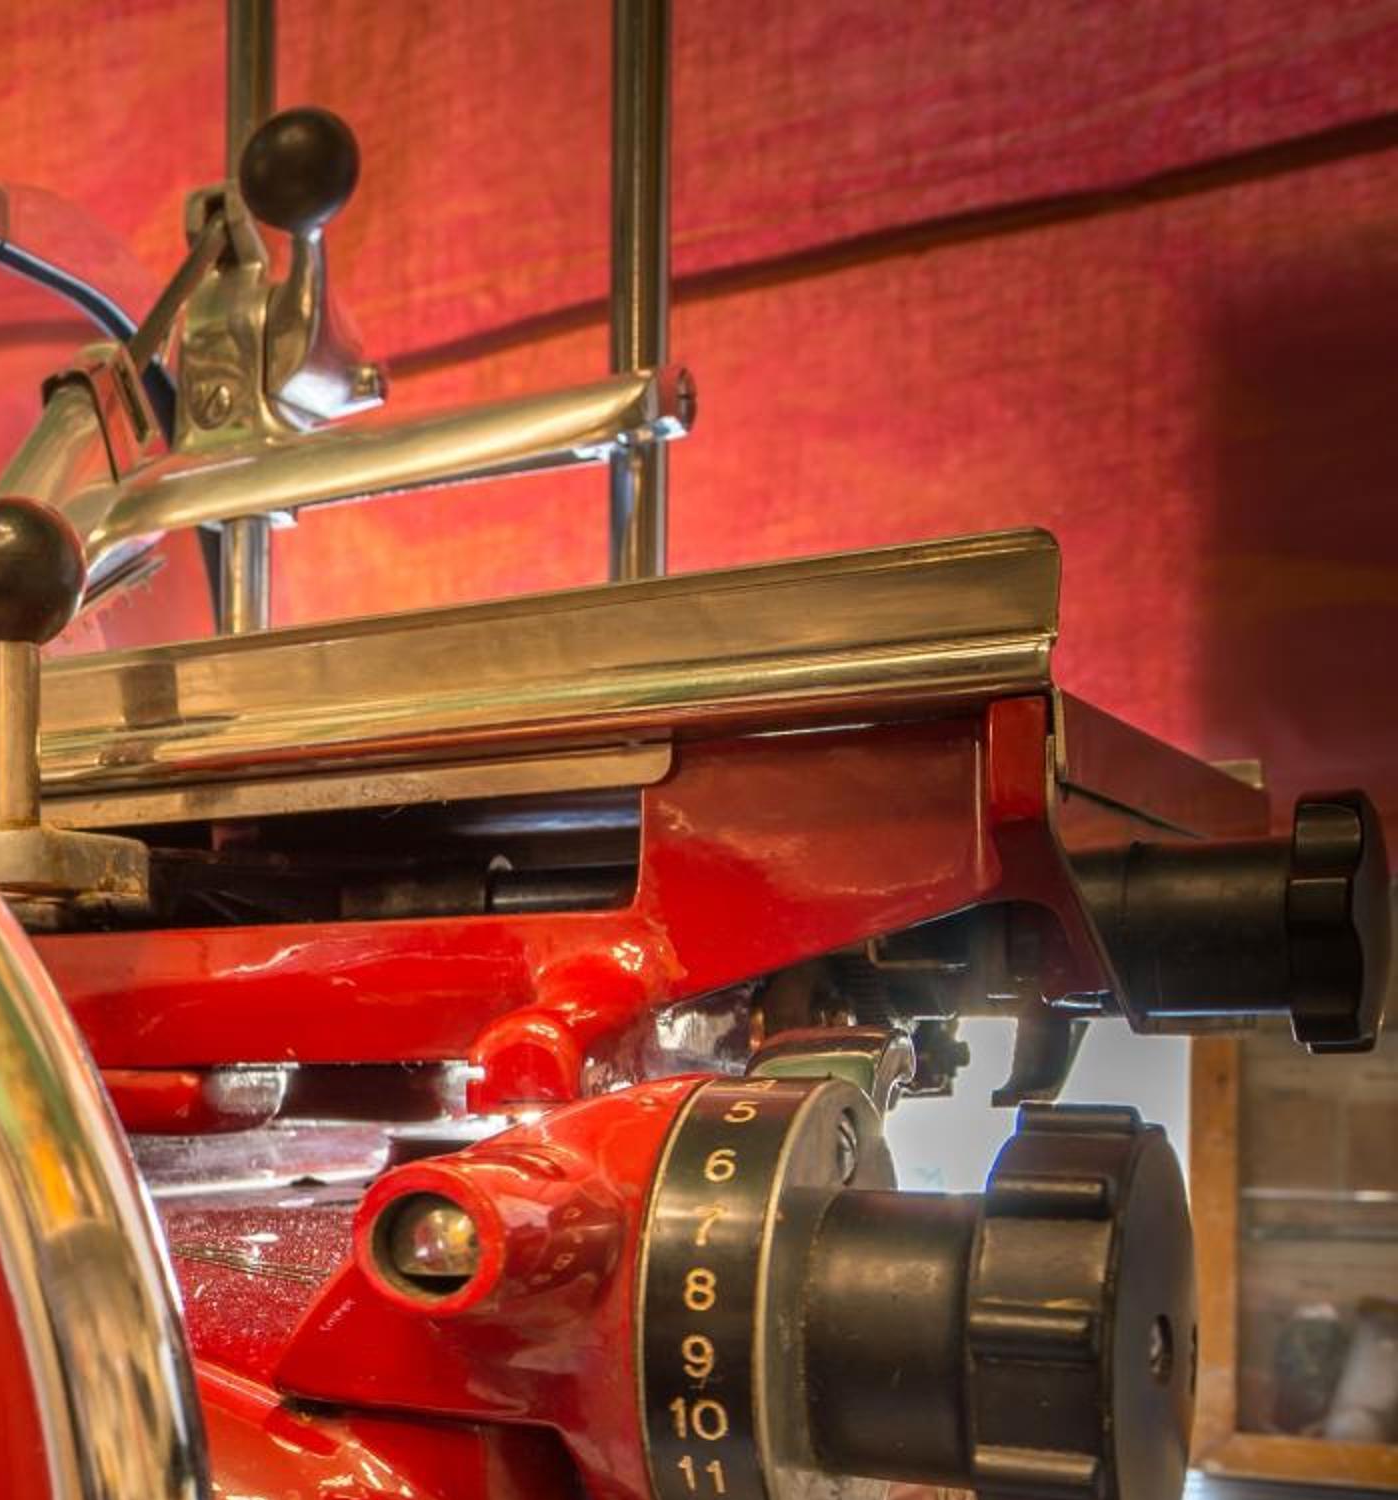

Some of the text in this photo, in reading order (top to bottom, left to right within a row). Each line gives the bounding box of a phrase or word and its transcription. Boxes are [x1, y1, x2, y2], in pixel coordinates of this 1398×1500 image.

[724, 1101, 760, 1122] 5
[705, 1149, 736, 1181] 6
[694, 1204, 729, 1246] 7
[684, 1267, 716, 1311] 8
[682, 1335, 714, 1379] 9
[670, 1397, 728, 1440] 10
[678, 1455, 725, 1493] 11
